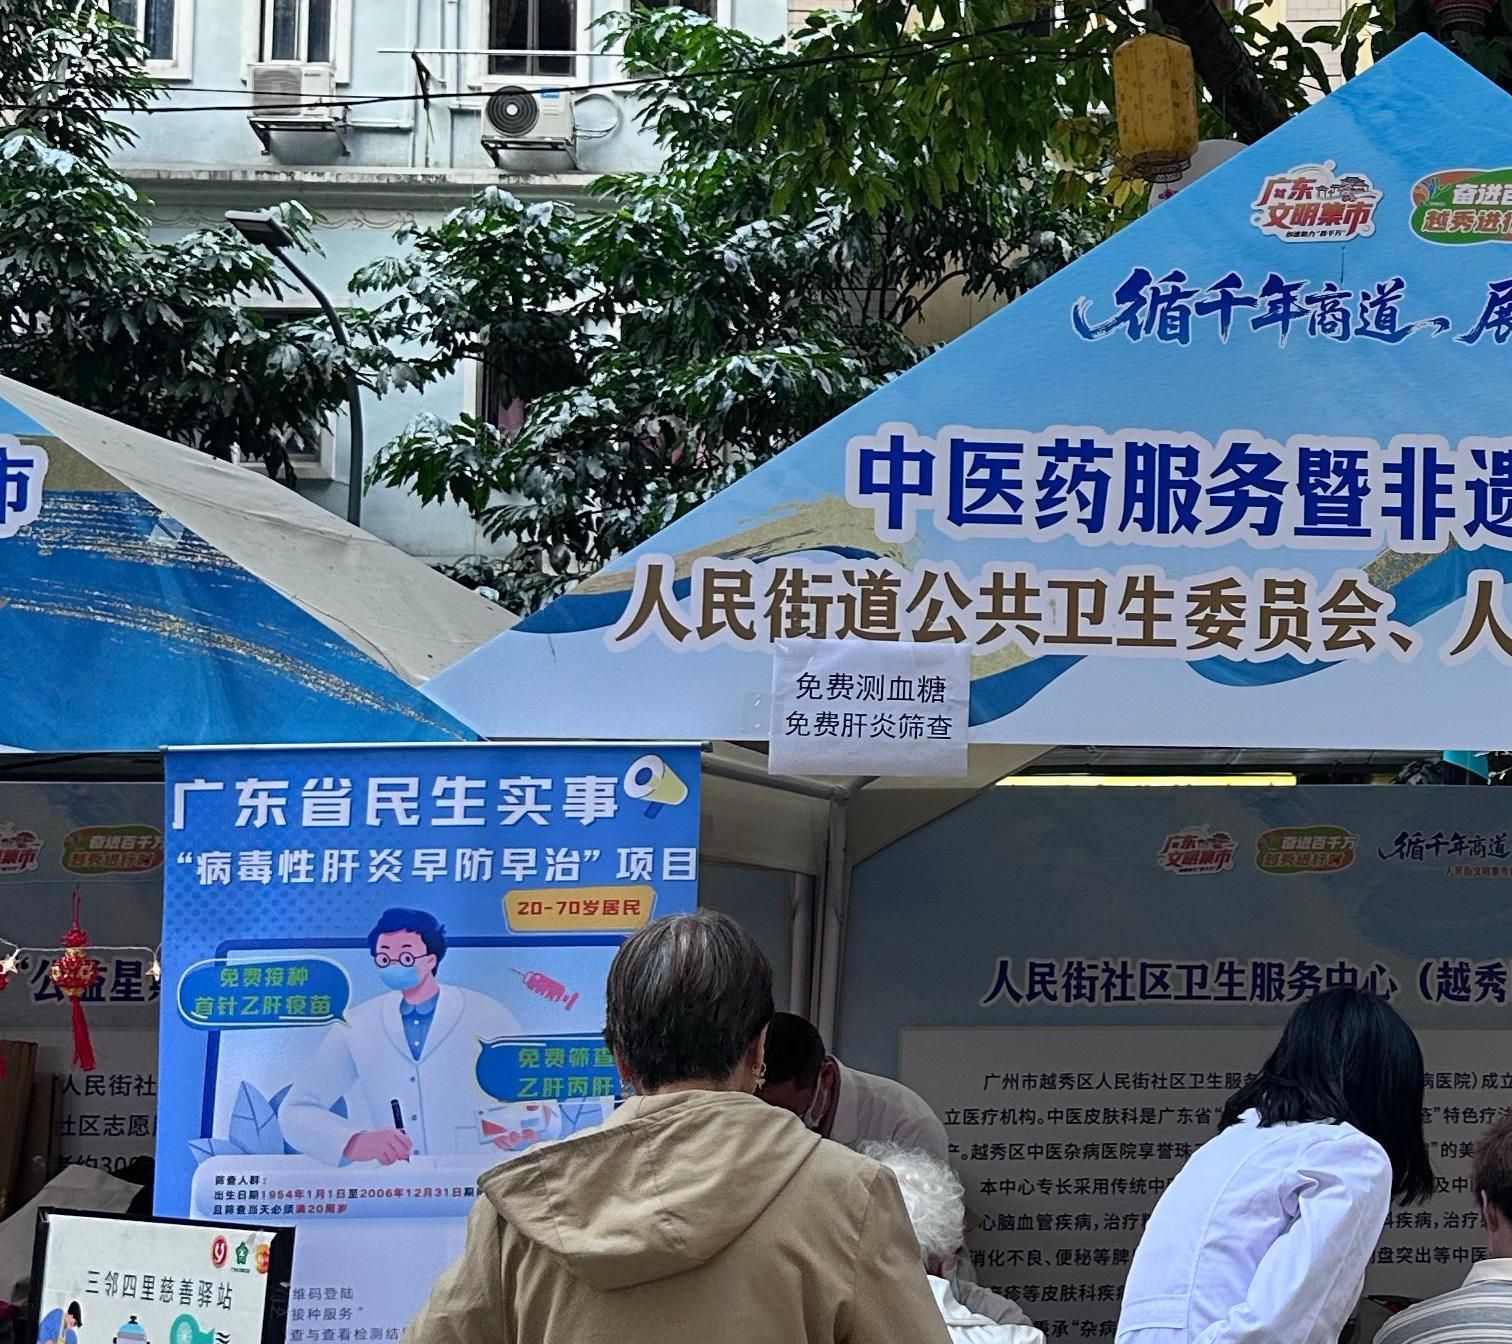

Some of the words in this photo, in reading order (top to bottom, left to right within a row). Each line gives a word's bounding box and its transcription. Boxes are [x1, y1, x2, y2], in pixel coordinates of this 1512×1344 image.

[1264, 202, 1374, 235] 文明集市
[795, 672, 947, 705] 免费测血糖
[784, 710, 953, 742] 免费肝炎筛查
[172, 774, 620, 830] 广东省民生实事
[517, 899, 642, 917] 20-70岁居民
[220, 966, 309, 987] 免费接种
[194, 995, 332, 1017] 首针乙肝疫苗
[517, 1076, 614, 1098] 乙肝丙肝
[948, 1142, 1204, 1161] 。越秀区中医杂病医院享誉珠
[978, 1213, 1152, 1232] 心脑血管疾病，治疗
[970, 1248, 1135, 1267] 消化不良、便秘等脾
[1370, 1246, 1487, 1265] 盘突出等中医
[85, 1270, 234, 1311] 三邻四里慈善驿站
